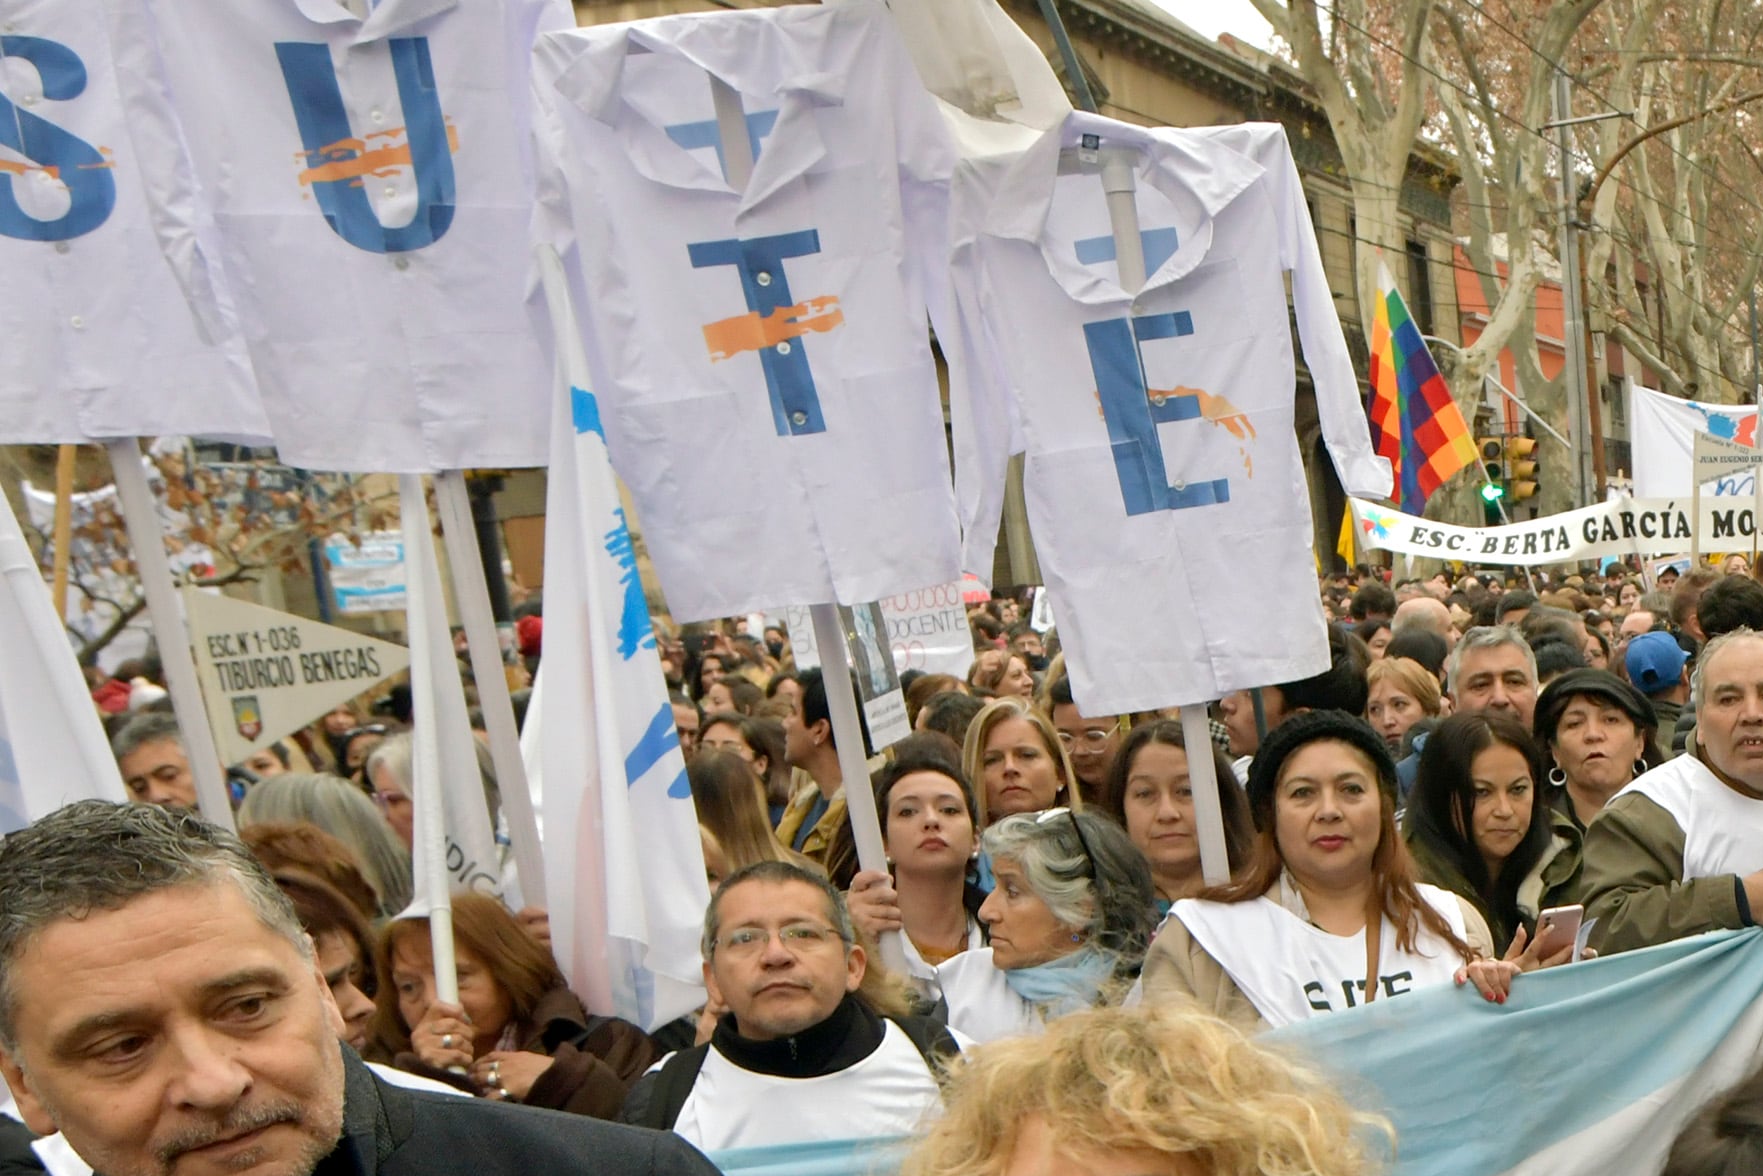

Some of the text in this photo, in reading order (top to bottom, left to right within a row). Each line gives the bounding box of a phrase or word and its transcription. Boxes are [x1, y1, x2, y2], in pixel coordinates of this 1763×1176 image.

[274, 37, 457, 253] U
[687, 229, 826, 437] T
[1083, 311, 1230, 517] E
[1700, 455, 1718, 464] JUAN
[1720, 455, 1750, 463] EUGENIO
[1583, 501, 1692, 545] GARCÍA
[887, 607, 967, 640] DOCENTE
[213, 646, 382, 693] TIBURCIO BENEGAS
